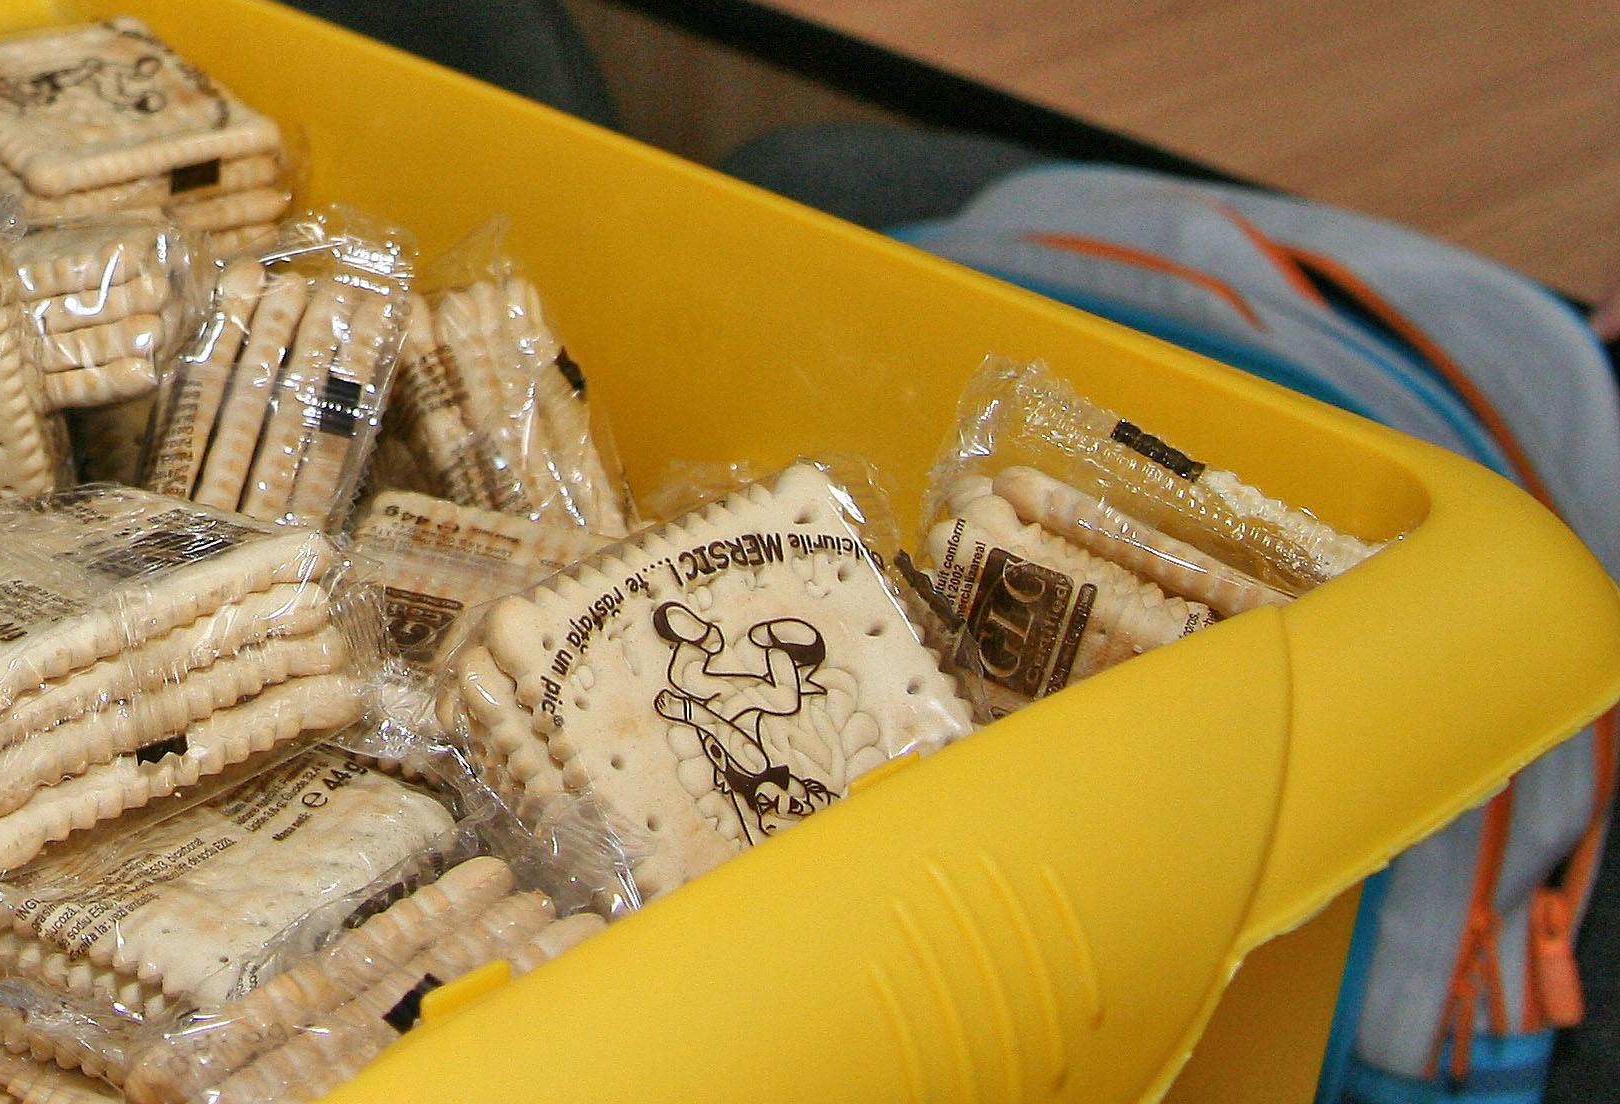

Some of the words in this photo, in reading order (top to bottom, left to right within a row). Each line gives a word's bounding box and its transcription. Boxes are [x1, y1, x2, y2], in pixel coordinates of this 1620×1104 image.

[943, 517, 966, 569] conform
[947, 563, 965, 593] 2002
[551, 648, 574, 677] un
[301, 791, 329, 809] e
[67, 917, 92, 941] sodiu
